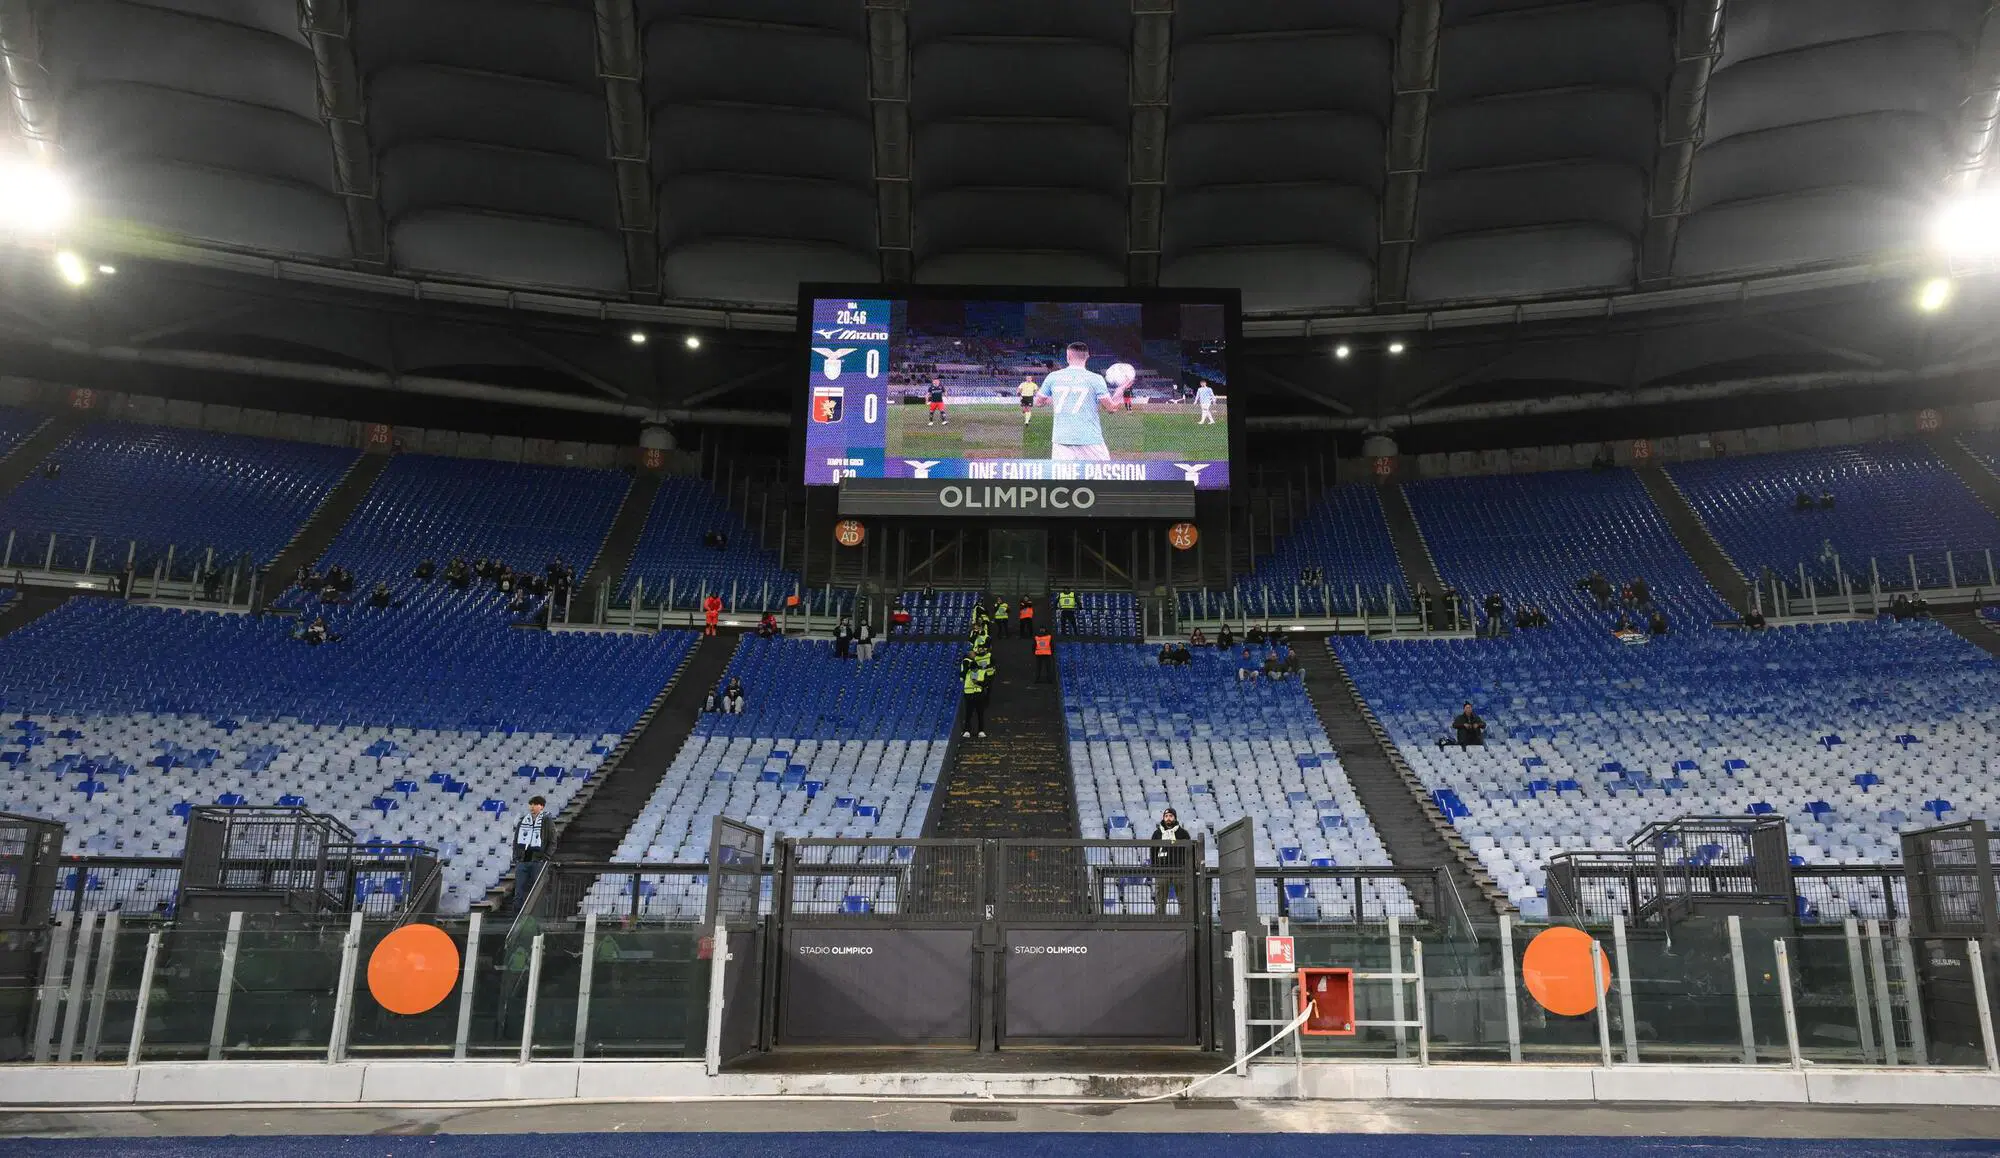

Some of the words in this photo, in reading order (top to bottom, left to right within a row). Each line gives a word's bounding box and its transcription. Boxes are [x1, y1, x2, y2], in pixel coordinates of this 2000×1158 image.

[836, 310, 867, 325] 20:46
[866, 349, 880, 379] 0
[1053, 386, 1090, 414] 77
[864, 393, 878, 424] 0
[371, 434, 388, 443] AD
[968, 462, 998, 480] ONE
[1052, 463, 1080, 480] ONE
[1084, 464, 1146, 481] PASSION
[939, 486, 1096, 509] OLIMPICO
[842, 520, 858, 531] 48
[1176, 523, 1191, 535] 47
[841, 531, 859, 543] AD
[1175, 535, 1191, 546] AS
[800, 946, 830, 954] STADIO
[831, 946, 873, 955] OLIMPICO
[1015, 946, 1045, 954] STADIO
[1046, 946, 1088, 954] OLIMPICO
